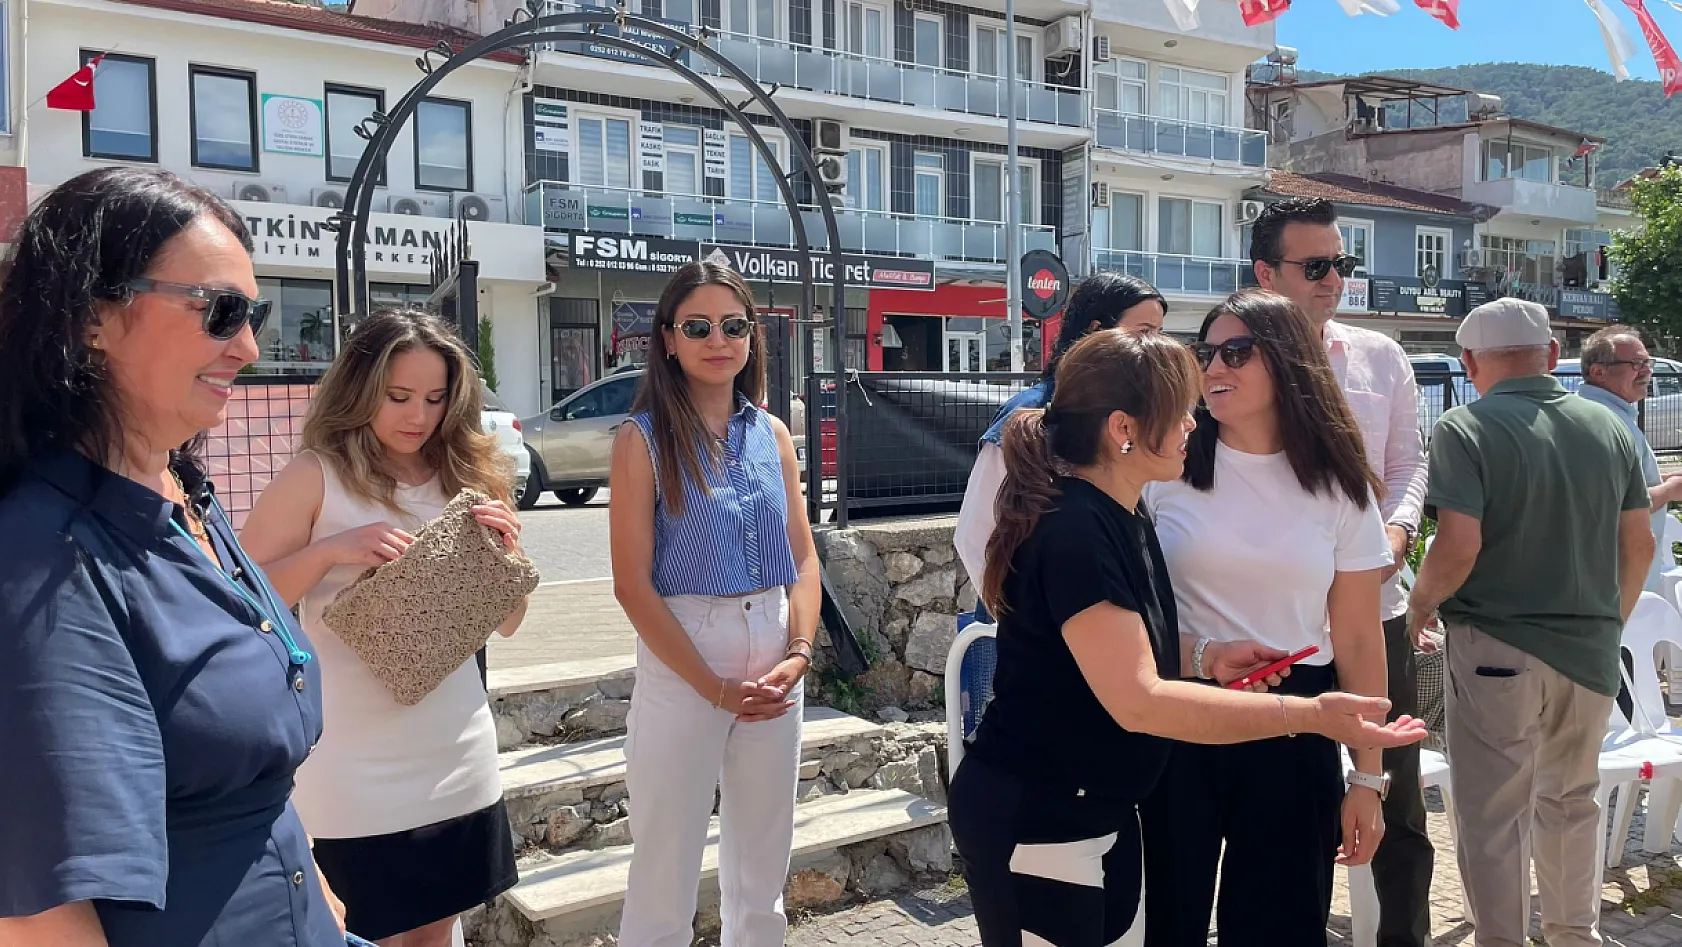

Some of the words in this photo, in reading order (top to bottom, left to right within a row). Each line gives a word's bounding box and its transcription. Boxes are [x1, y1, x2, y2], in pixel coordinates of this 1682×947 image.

[549, 198, 579, 211] FSM
[245, 214, 320, 240] TKİN
[575, 235, 648, 261] FSM
[734, 251, 799, 277] Volkan
[809, 256, 870, 281] Ticret
